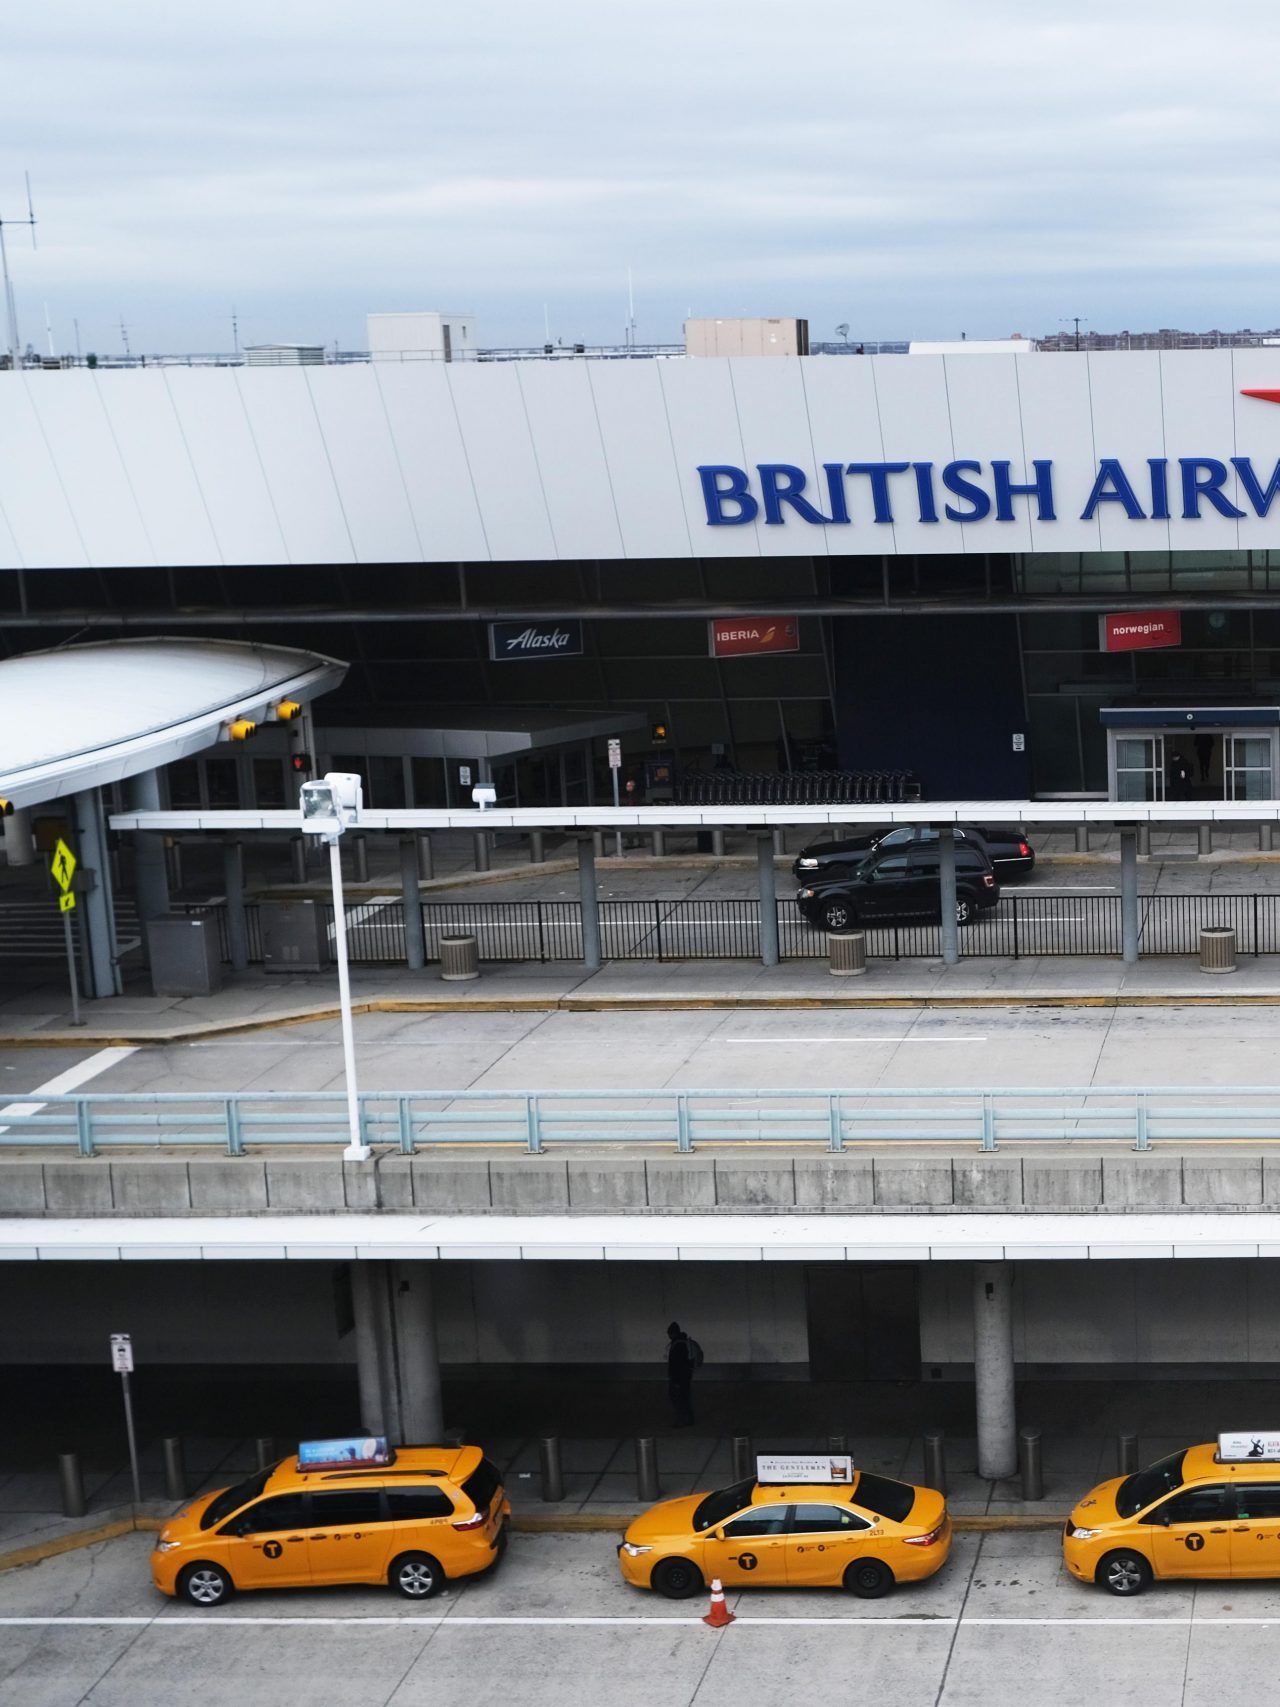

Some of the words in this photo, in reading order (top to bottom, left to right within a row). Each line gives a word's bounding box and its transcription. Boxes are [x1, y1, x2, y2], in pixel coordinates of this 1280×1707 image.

[695, 459, 1056, 527] BRITISH
[716, 629, 760, 642] IBERIA
[1113, 622, 1164, 636] norwegian
[506, 627, 570, 650] Alaska
